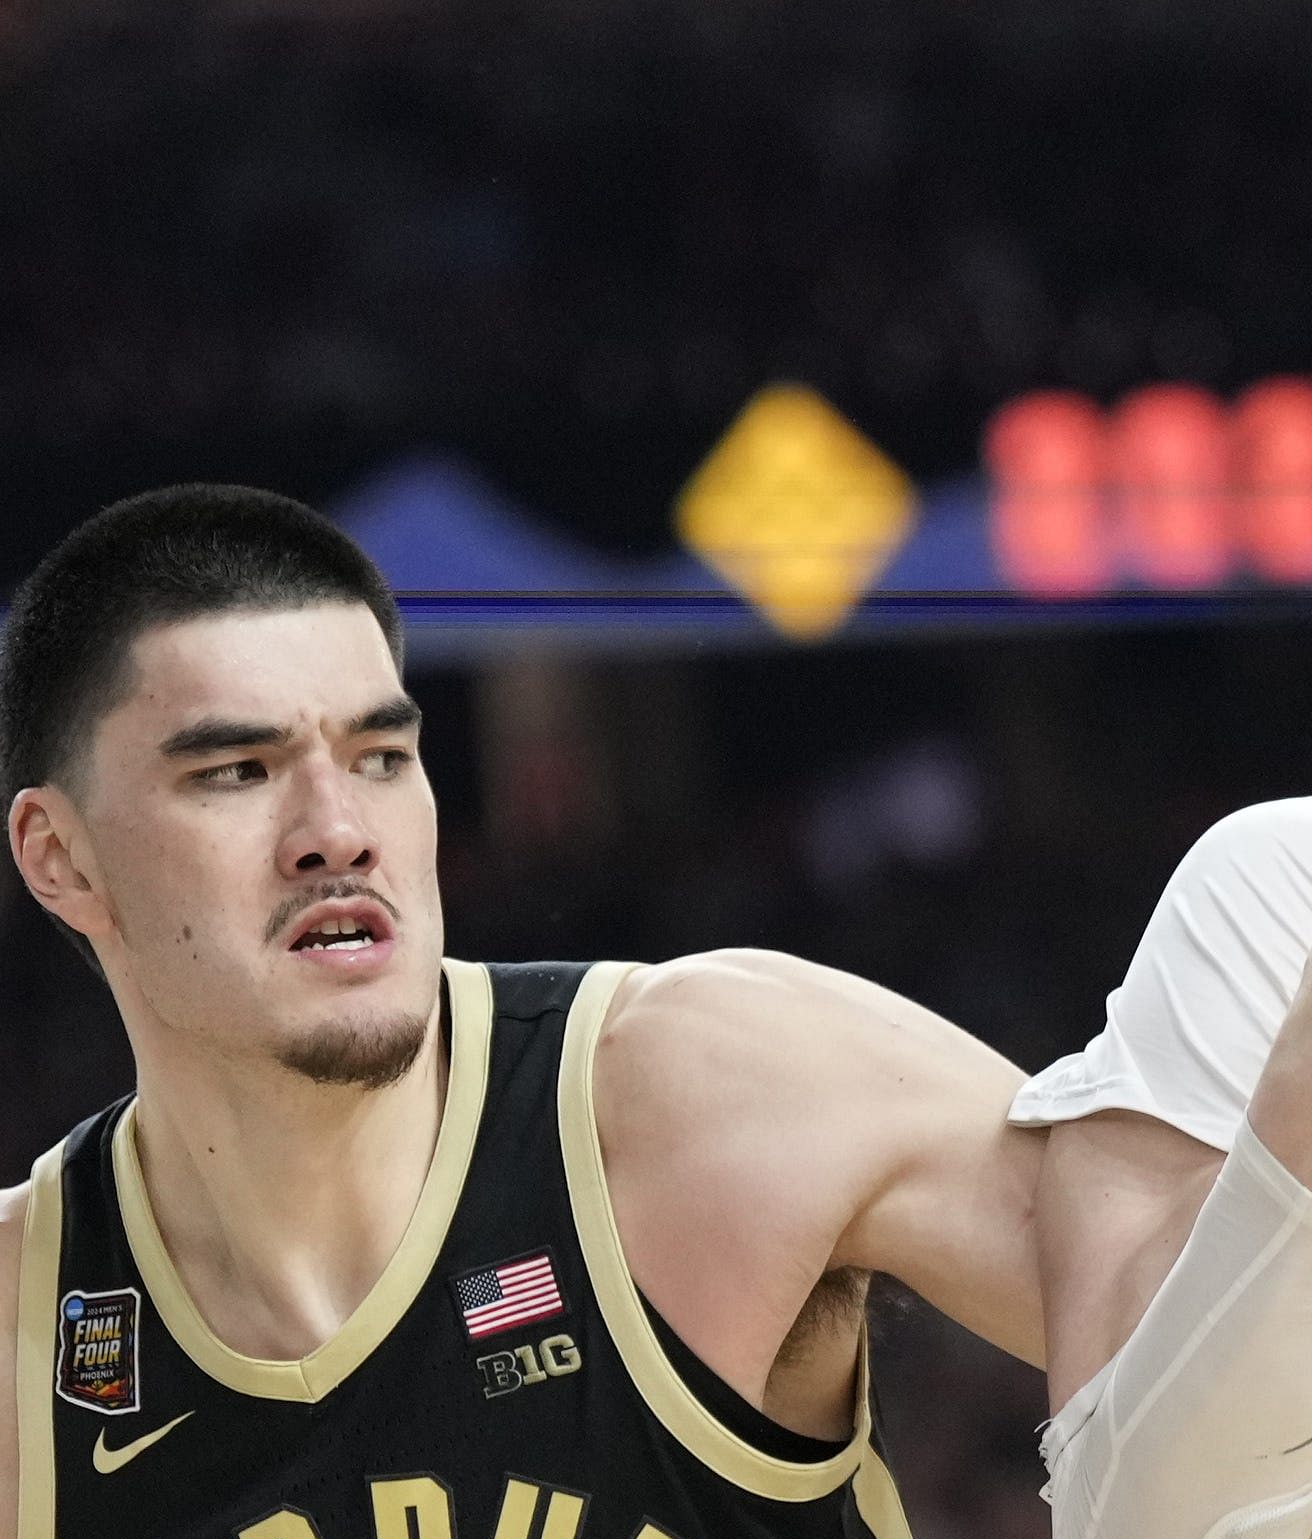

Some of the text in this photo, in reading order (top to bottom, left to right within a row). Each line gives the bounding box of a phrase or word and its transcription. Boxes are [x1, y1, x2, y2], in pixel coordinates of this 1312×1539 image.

[74, 1315, 122, 1345] FINAL
[73, 1340, 121, 1368] FOUR
[80, 1369, 115, 1381] PHOENIX
